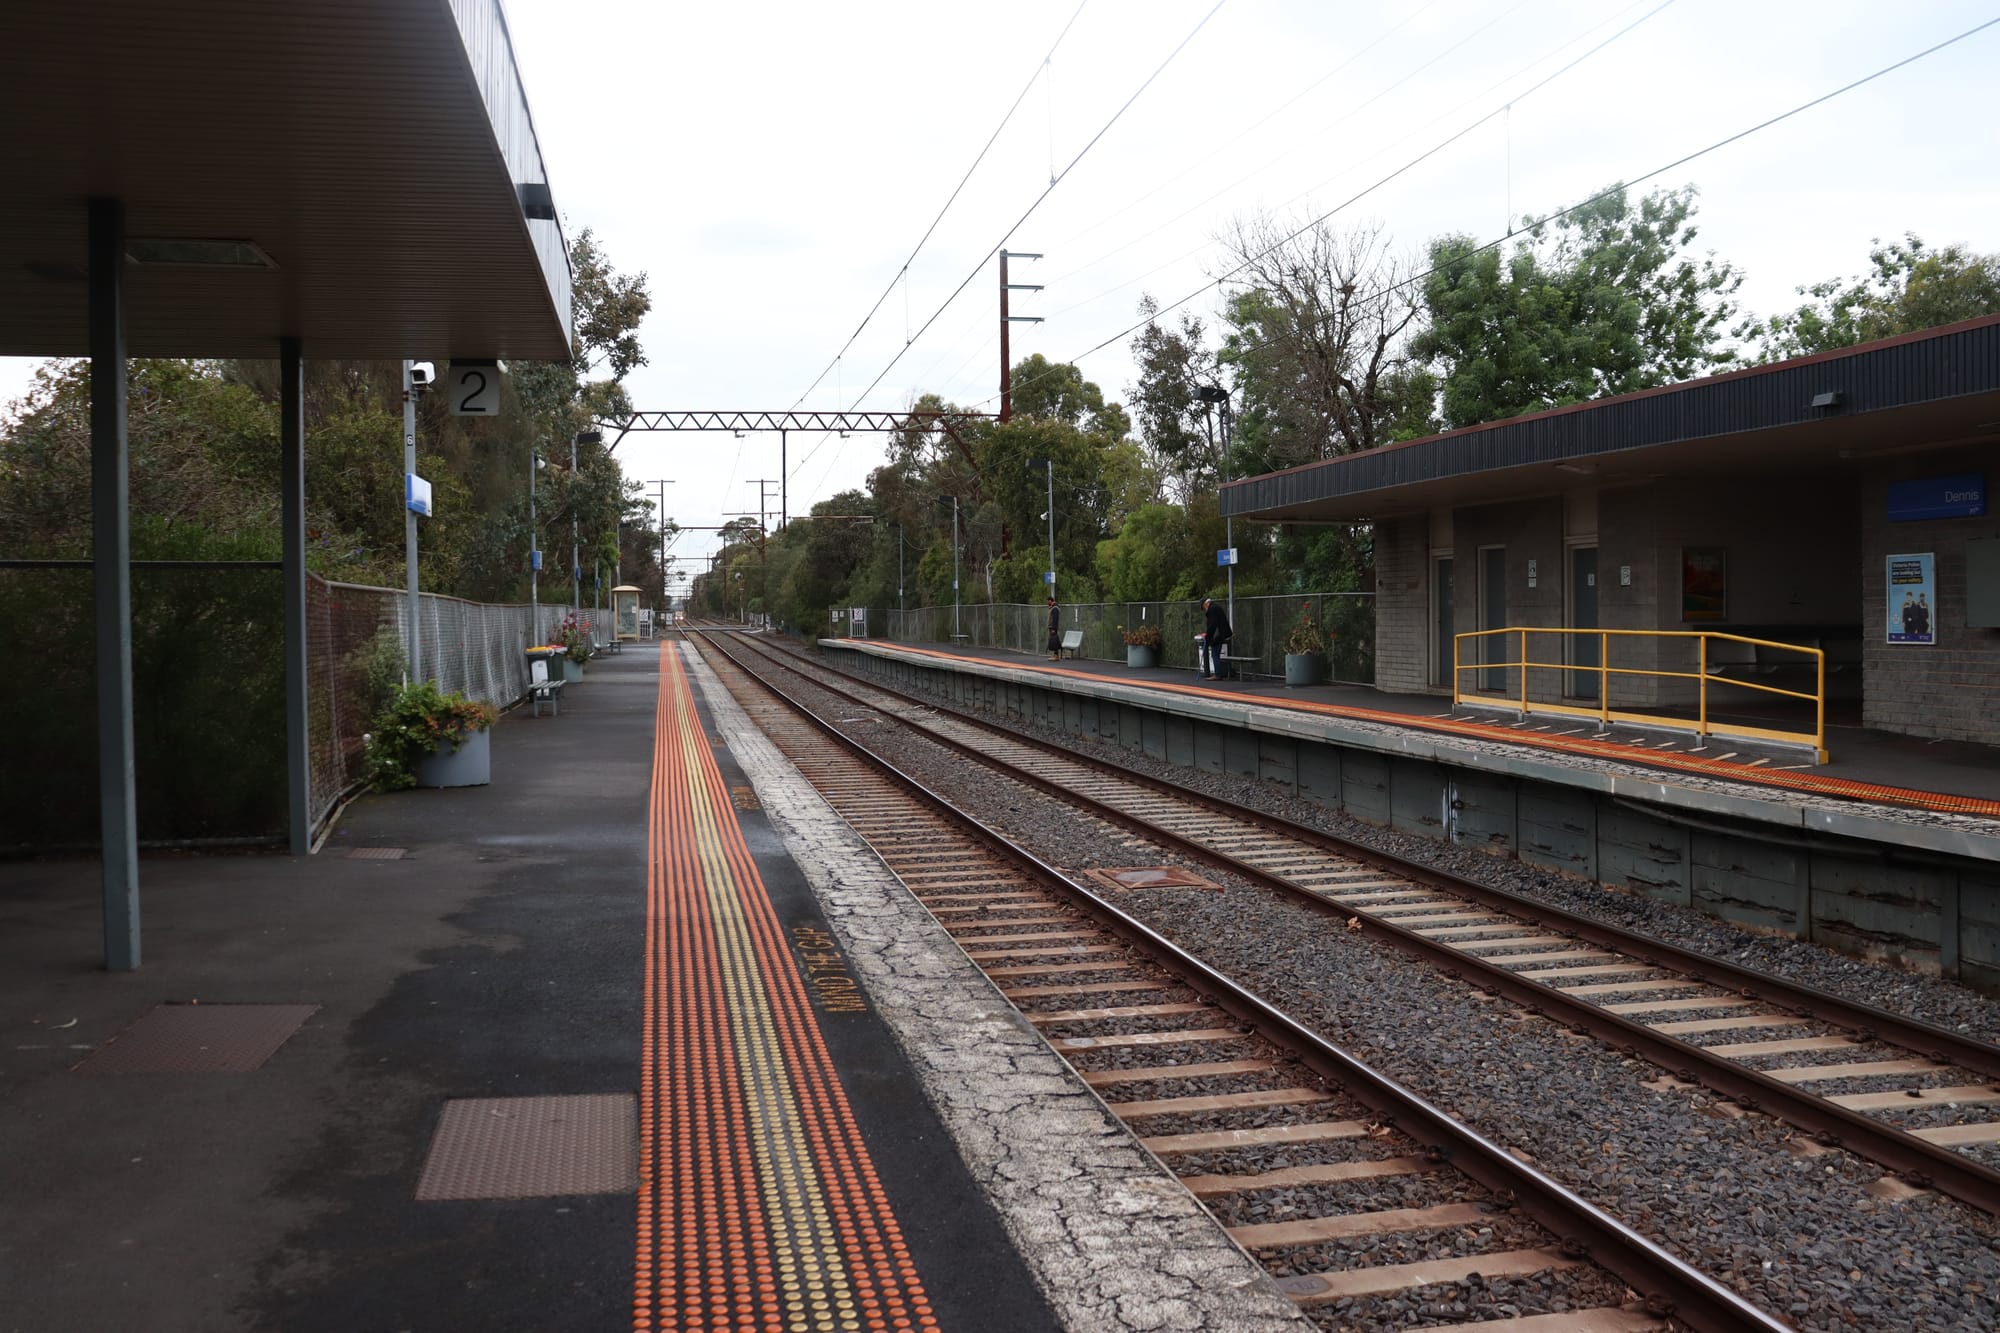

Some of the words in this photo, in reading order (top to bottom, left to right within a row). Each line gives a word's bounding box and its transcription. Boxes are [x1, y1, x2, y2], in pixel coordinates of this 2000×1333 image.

[460, 371, 487, 412] 2
[407, 435, 413, 445] 6
[1944, 488, 1980, 503] Dennis
[792, 927, 835, 949] GAP
[802, 952, 848, 974] THE
[814, 976, 867, 1012] MIND
